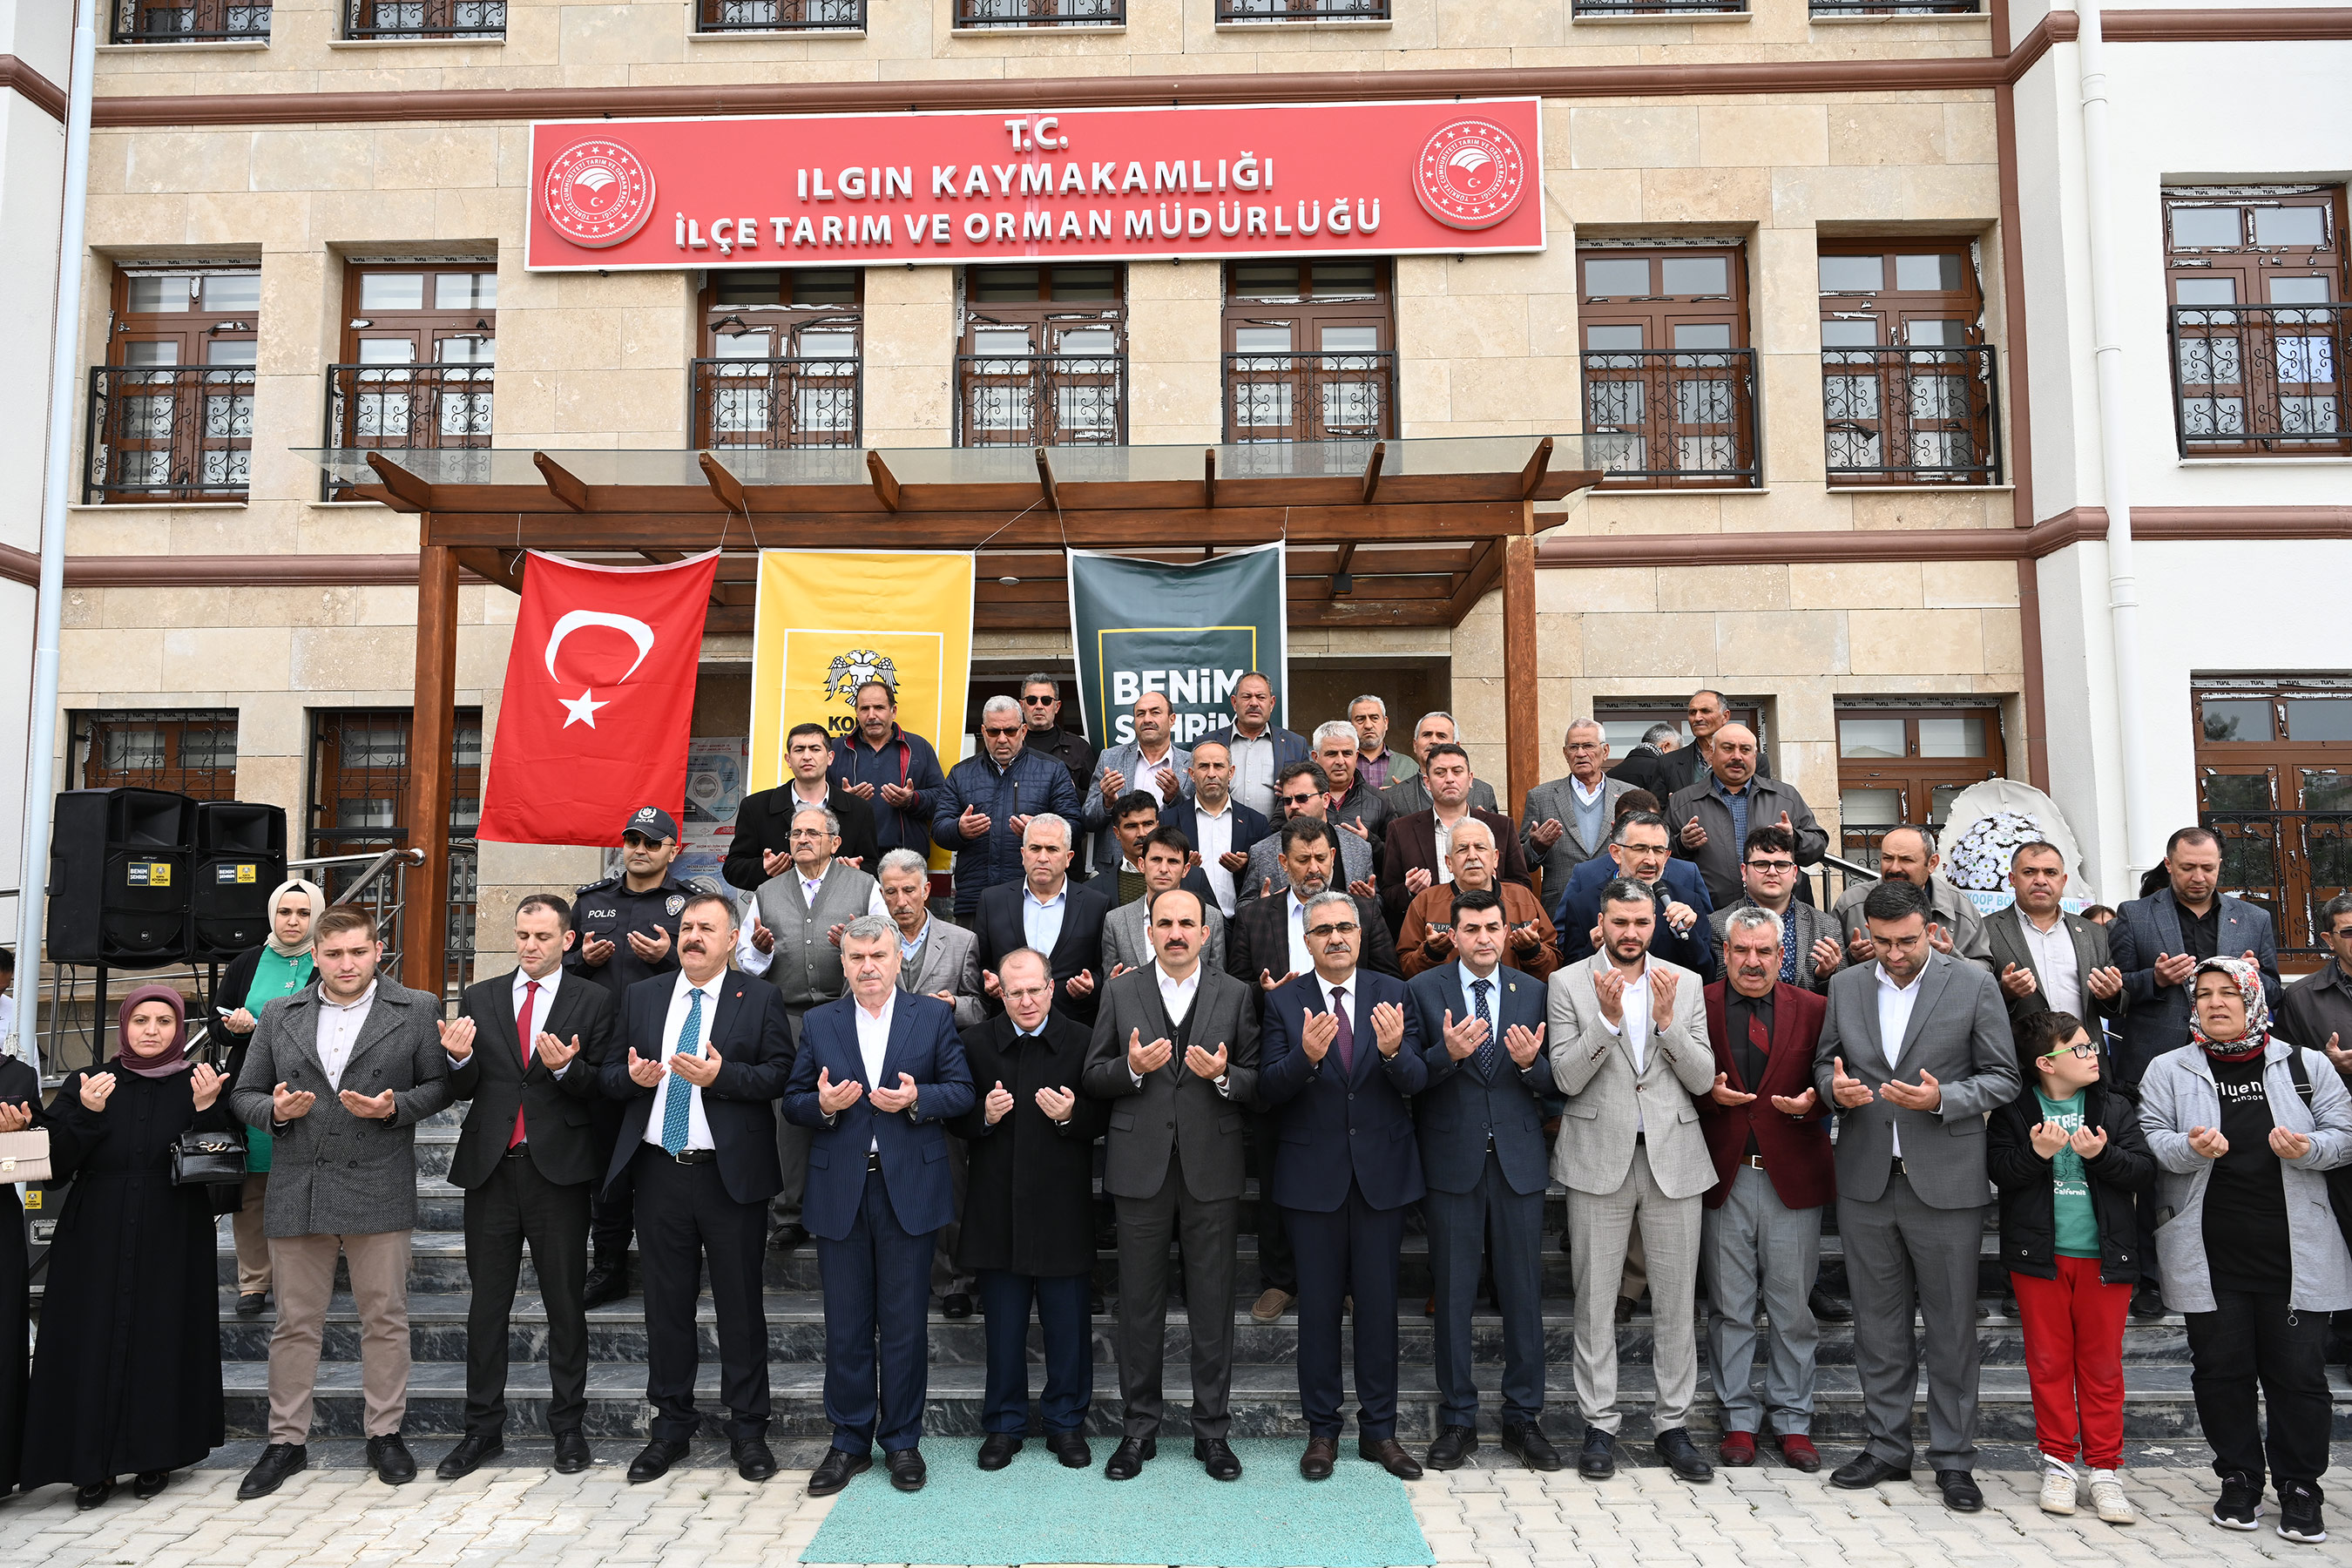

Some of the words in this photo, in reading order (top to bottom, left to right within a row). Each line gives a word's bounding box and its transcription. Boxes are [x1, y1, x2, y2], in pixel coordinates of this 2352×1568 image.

[1004, 116, 1069, 152] T.C.
[1490, 147, 1504, 169] ORMAN
[615, 168, 627, 190] ORMAN
[797, 166, 913, 201] ILGIN
[931, 150, 1274, 199] KAYMAKAMLIĞI
[675, 211, 758, 255] İLÇE
[769, 214, 892, 246] TARIM
[903, 213, 950, 243] VE
[963, 209, 1112, 243] ORMAN
[1124, 196, 1382, 240] MÜDÜRLÜĞÜ
[2054, 1187, 2086, 1196] California
